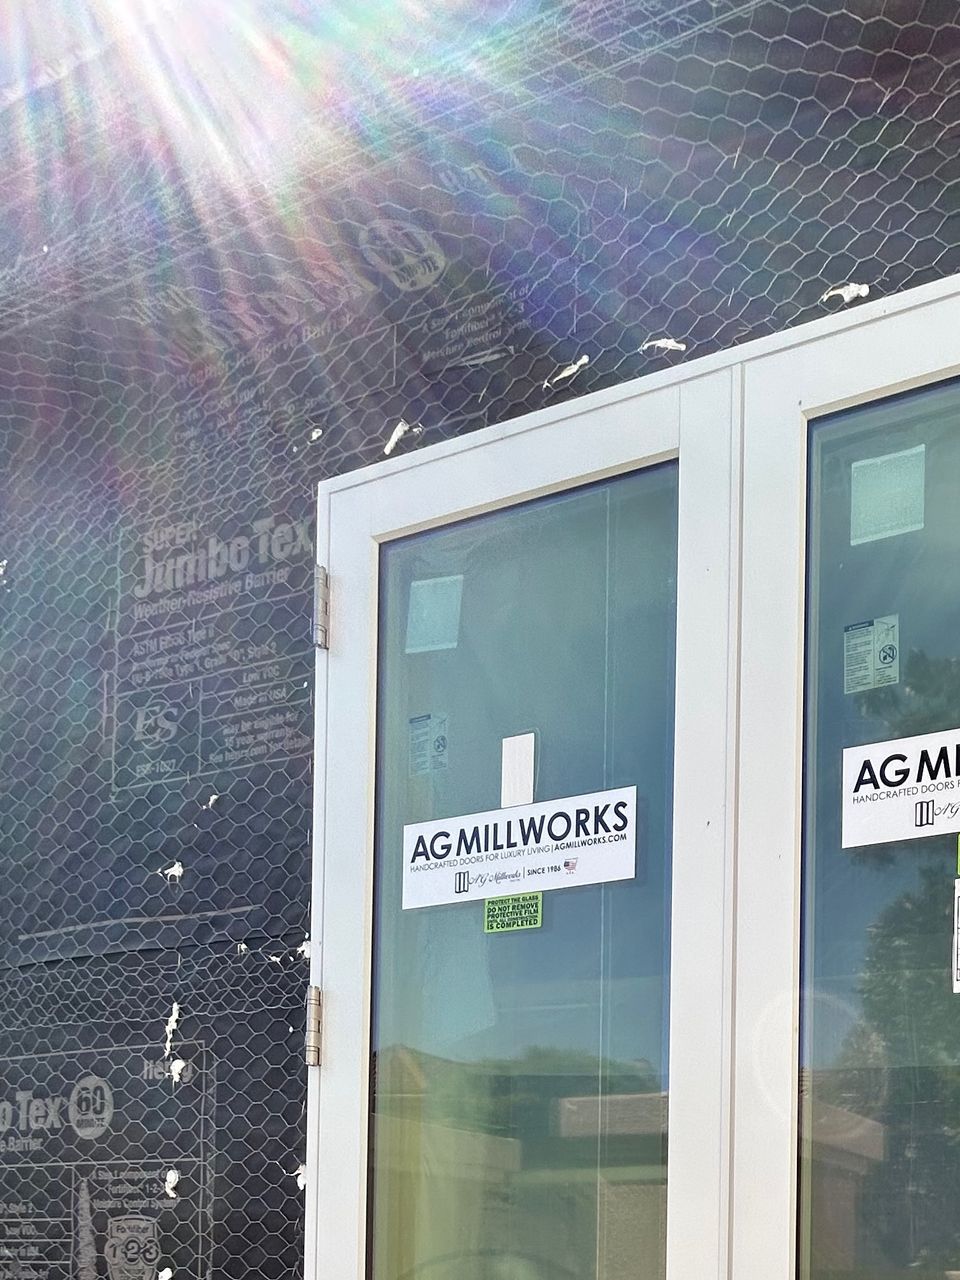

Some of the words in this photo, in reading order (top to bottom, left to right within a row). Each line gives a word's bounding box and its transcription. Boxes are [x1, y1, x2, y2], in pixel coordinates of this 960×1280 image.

[134, 535, 250, 599] Jumbo
[251, 515, 312, 564] Tex
[852, 786, 919, 804] HANDCRAFTED
[921, 780, 955, 794] DOORS
[410, 859, 458, 872] HANDCRAFTED
[460, 856, 484, 866] DOORS
[485, 853, 499, 863] FOR
[500, 849, 525, 860] LUXURY
[527, 845, 550, 856] LIVING
[527, 868, 545, 876] SINCE
[512, 902, 538, 910] REMOVE
[496, 919, 538, 929] COMPLETED
[16, 1091, 62, 1130] Tex
[76, 1086, 106, 1117] 60
[8, 1137, 43, 1151] Barrier
